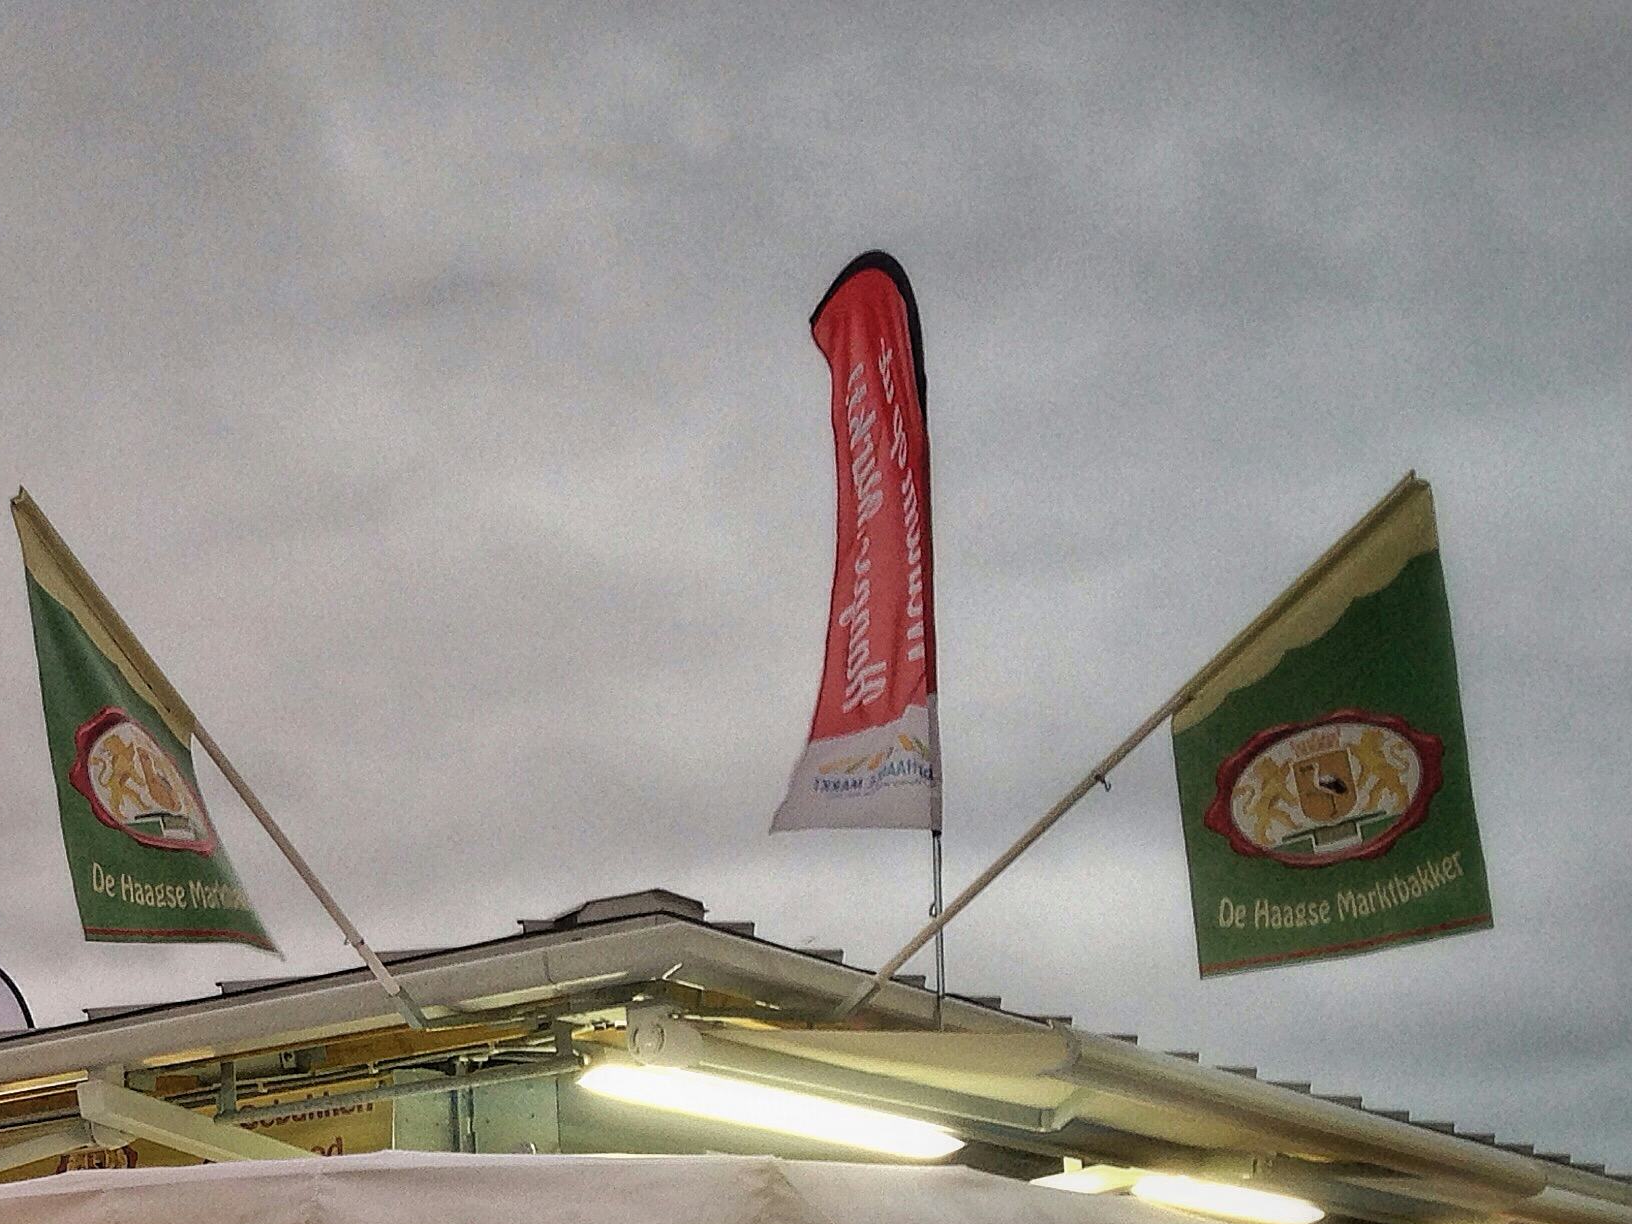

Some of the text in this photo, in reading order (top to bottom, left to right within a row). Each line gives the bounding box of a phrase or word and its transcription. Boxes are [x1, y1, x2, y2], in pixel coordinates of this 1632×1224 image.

[91, 861, 116, 898] De
[120, 873, 187, 910] Haagse
[1217, 851, 1465, 931] De Haagse Marktbakker
